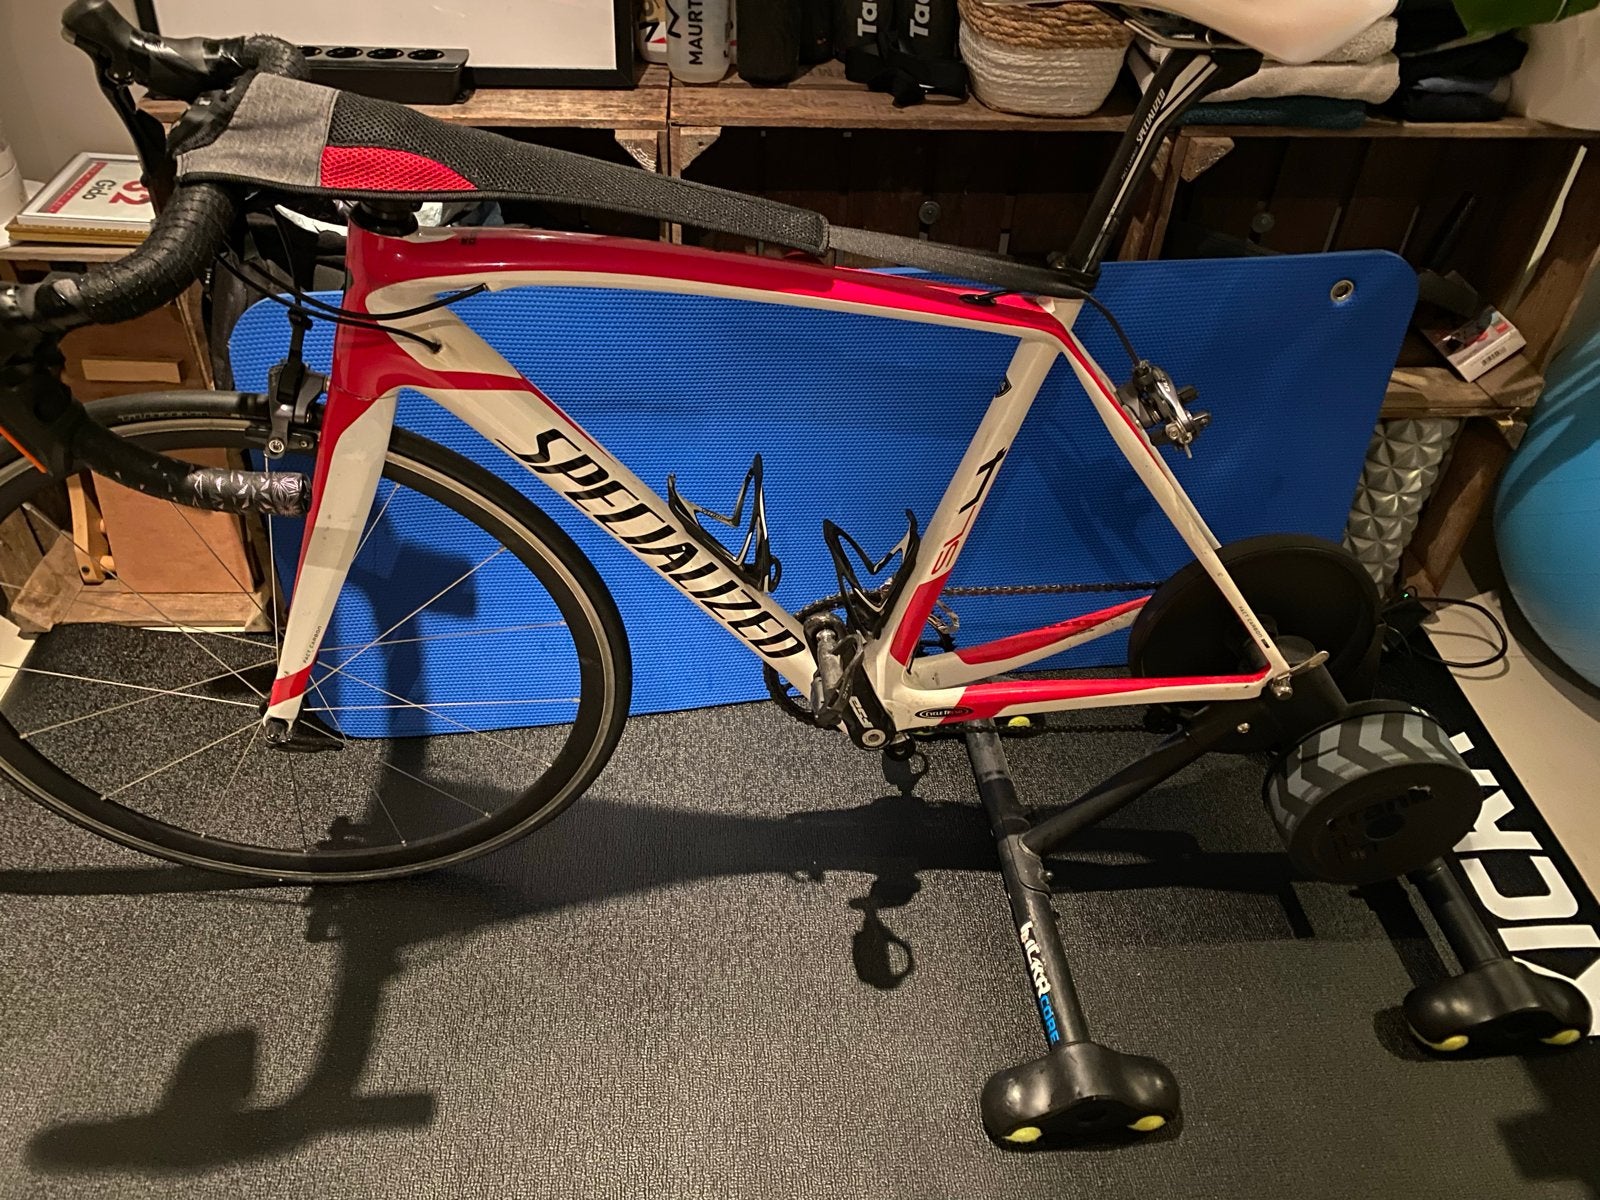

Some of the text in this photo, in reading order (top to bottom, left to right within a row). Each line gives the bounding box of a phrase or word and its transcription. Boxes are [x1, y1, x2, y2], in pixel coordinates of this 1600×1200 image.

[857, 0, 877, 37] Ta
[909, 0, 930, 38] Ta
[1136, 88, 1166, 145] SPECIALIZED
[496, 428, 806, 658] SPECIALIZED
[1040, 993, 1061, 1046] CORE
